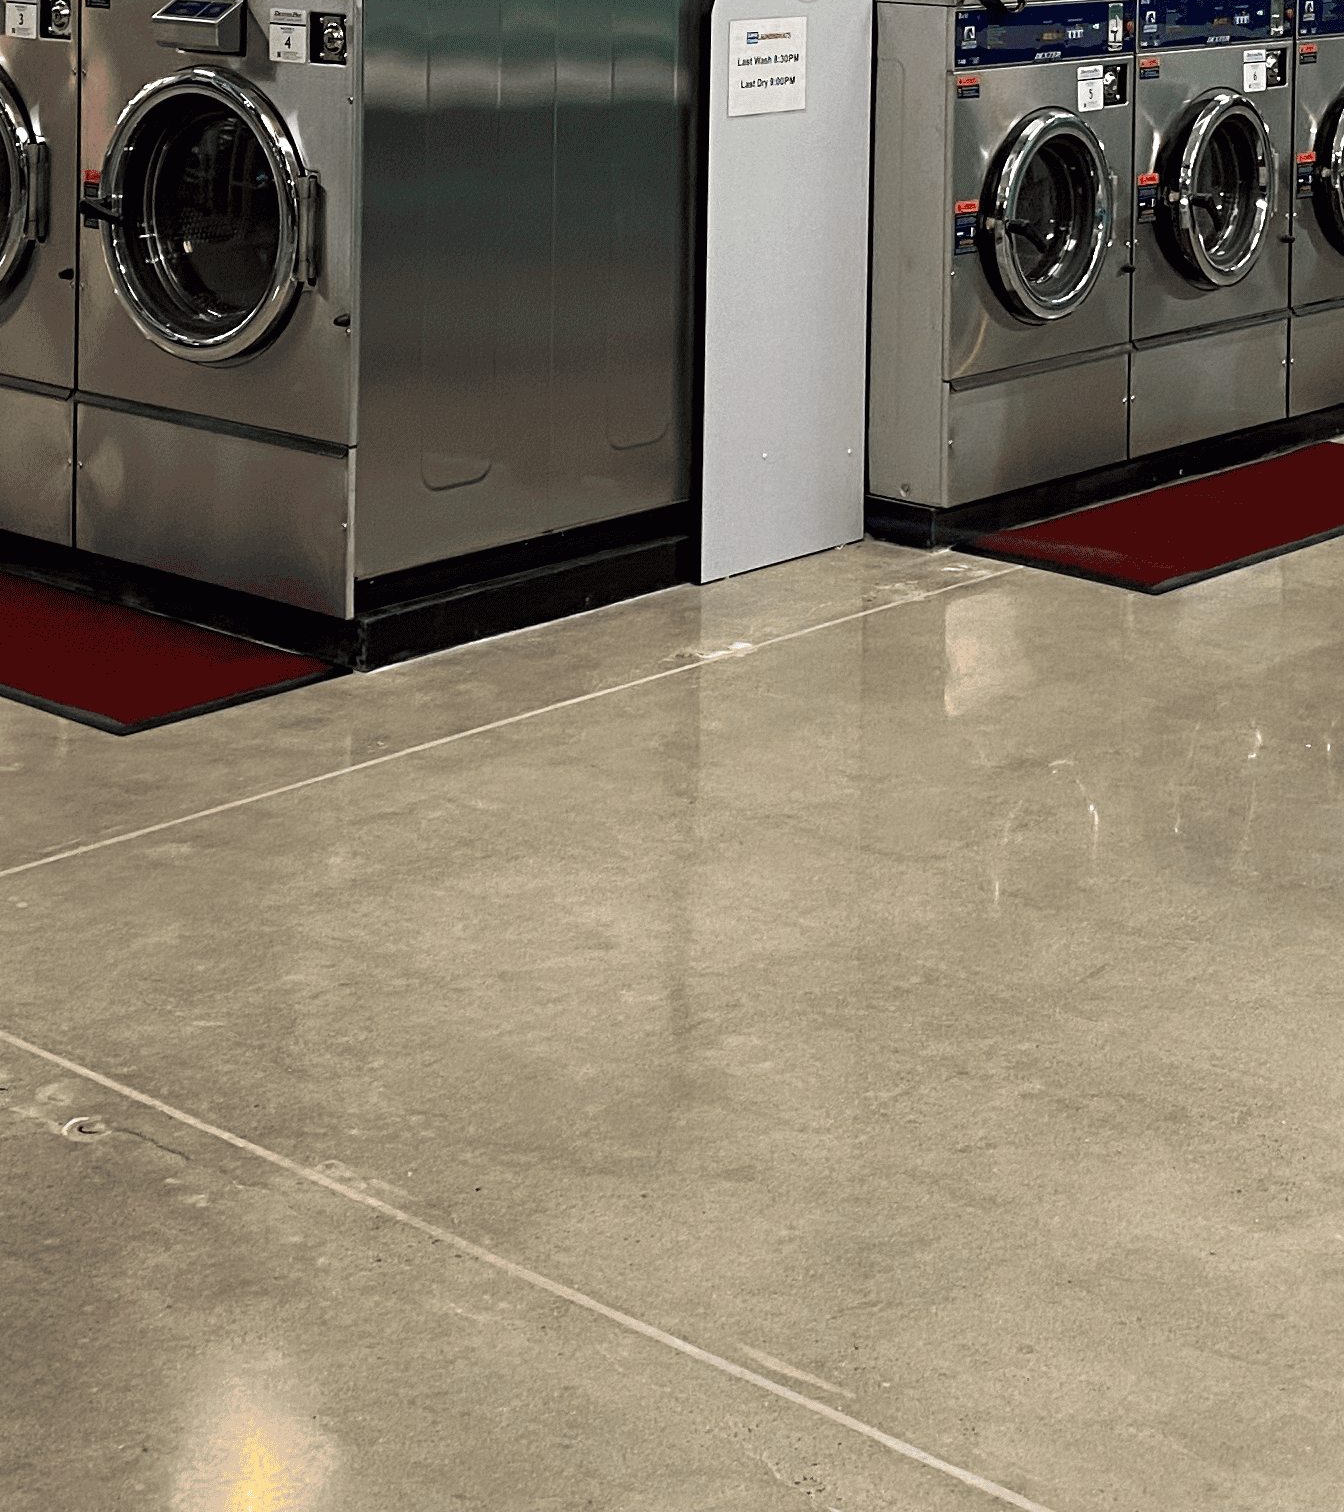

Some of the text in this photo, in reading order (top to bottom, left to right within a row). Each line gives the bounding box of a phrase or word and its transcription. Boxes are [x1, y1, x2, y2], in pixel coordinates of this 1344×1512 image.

[18, 13, 23, 26] 3
[285, 36, 291, 49] 4
[1034, 51, 1062, 60] DEXTER
[1089, 88, 1094, 99] 5
